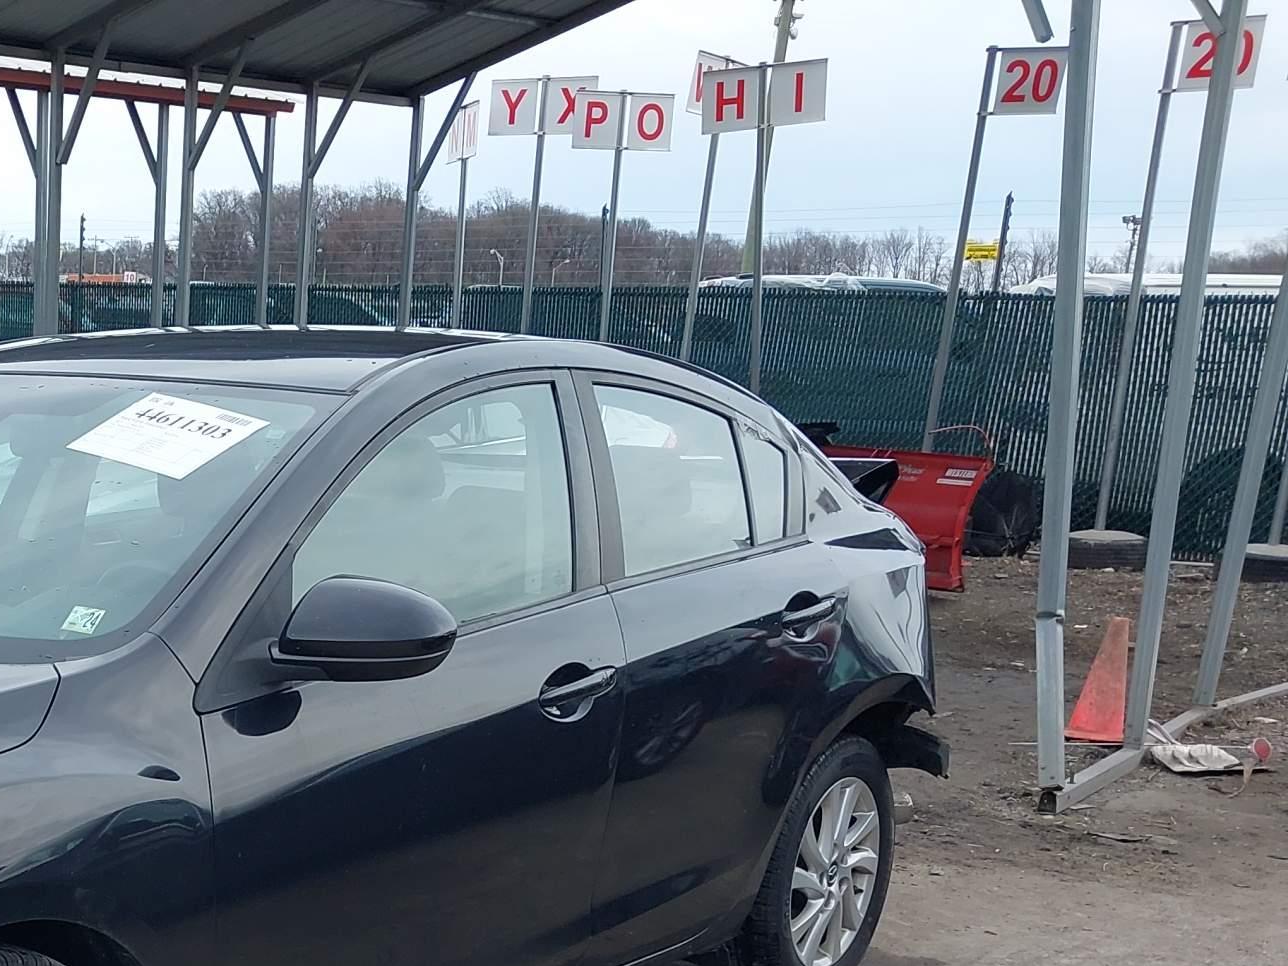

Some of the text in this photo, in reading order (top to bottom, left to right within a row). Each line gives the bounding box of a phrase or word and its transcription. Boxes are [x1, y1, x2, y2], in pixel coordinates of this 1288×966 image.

[794, 71, 804, 113] I
[1000, 59, 1059, 103] 20
[501, 88, 528, 125] Y
[584, 101, 609, 138] P
[715, 79, 745, 122] H
[636, 103, 665, 141] O
[135, 408, 233, 439] 44611303
